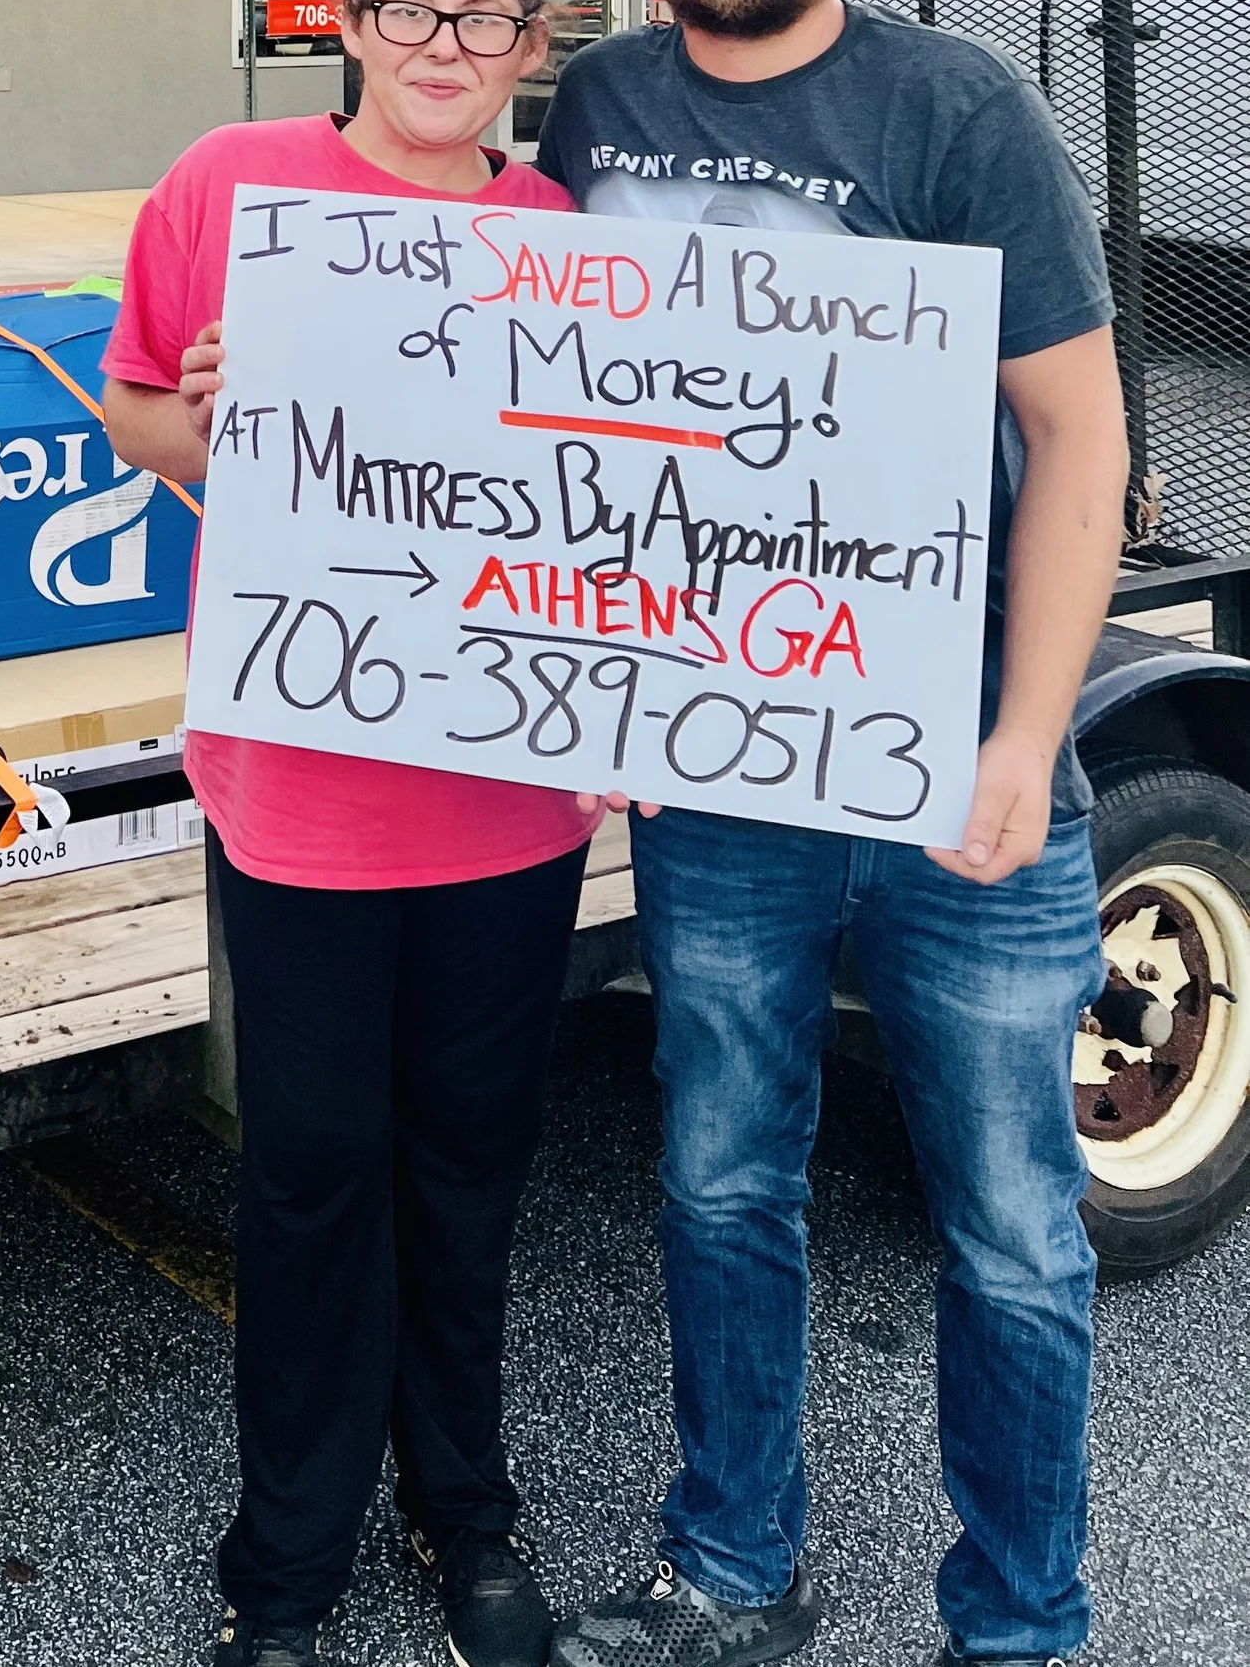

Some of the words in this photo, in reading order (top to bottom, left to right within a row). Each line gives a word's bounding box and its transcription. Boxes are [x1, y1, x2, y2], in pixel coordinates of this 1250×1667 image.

[590, 145, 676, 178] KENNY
[690, 156, 856, 206] CHESNEY
[239, 199, 310, 260] I
[325, 210, 462, 289] Just
[470, 211, 651, 320] SAVED
[667, 232, 703, 310] A
[733, 248, 948, 351] Bunch
[399, 303, 475, 377] of
[509, 318, 841, 470] Money!
[212, 400, 278, 460] AT
[291, 399, 542, 540] MATTRESS
[556, 440, 636, 590] By
[641, 455, 983, 620] Appointment
[461, 555, 728, 664] ATHENS
[740, 578, 866, 679] GA
[233, 593, 931, 822] 706-389-0513
